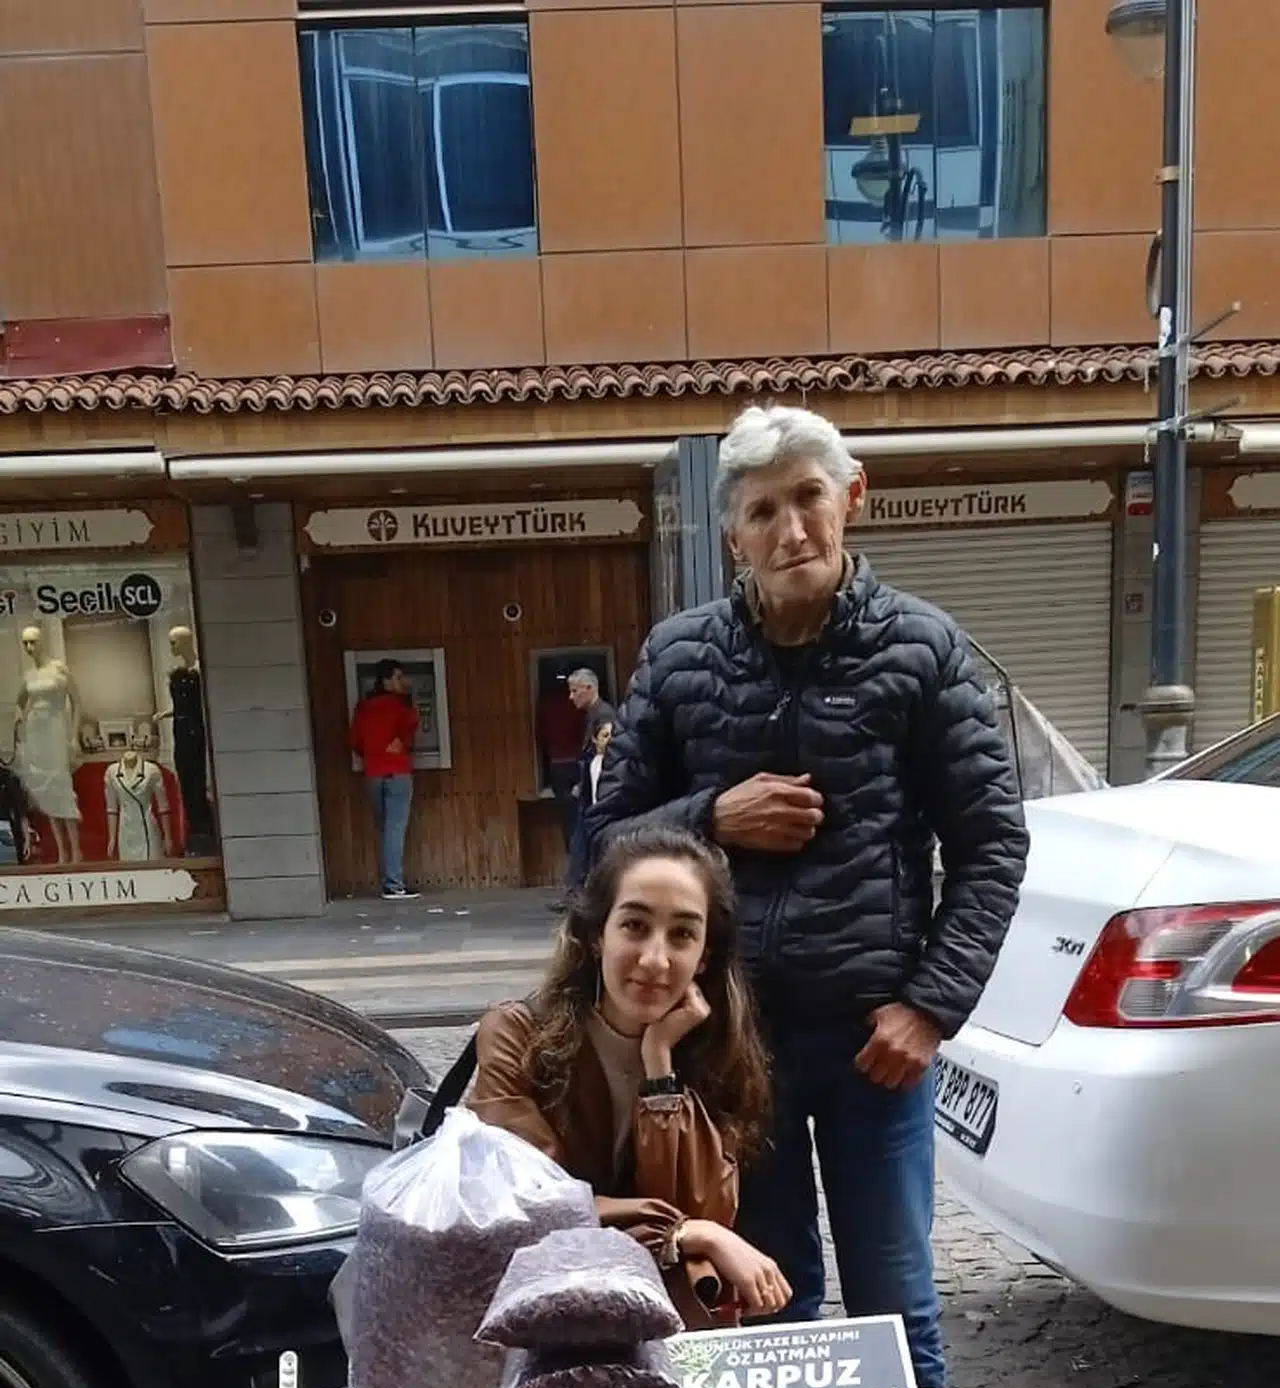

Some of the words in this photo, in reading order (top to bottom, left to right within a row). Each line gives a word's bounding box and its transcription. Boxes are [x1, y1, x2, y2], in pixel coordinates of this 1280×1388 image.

[124, 585, 158, 606] SCL
[44, 878, 137, 903] GİYİM
[963, 1080, 996, 1130] 877
[754, 1337, 790, 1349] TAZE
[791, 1334, 808, 1346] EL
[808, 1330, 861, 1344] YAPIMI
[726, 1349, 751, 1366] ÖZ
[754, 1345, 831, 1363] BATMAN
